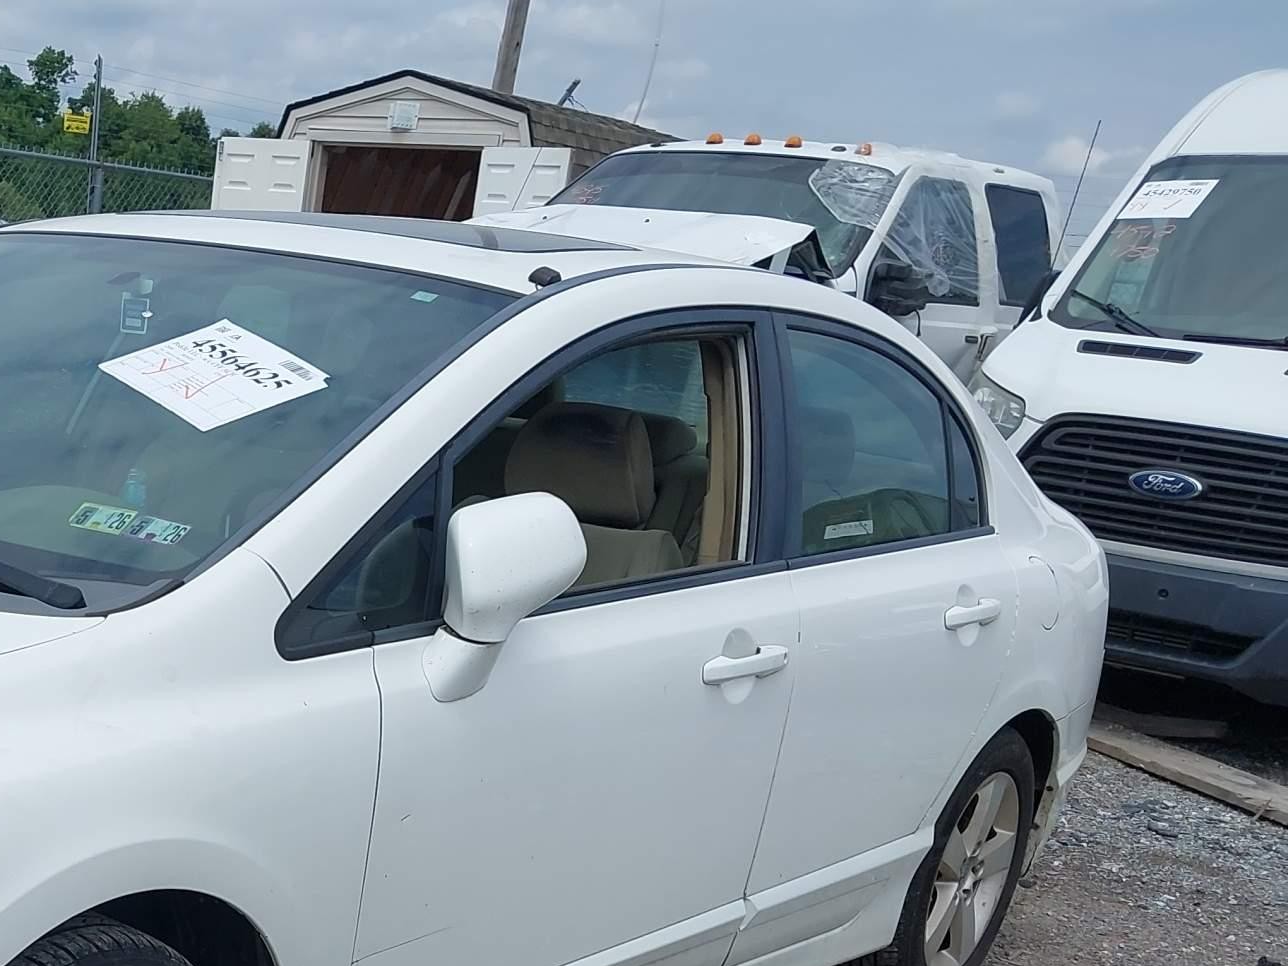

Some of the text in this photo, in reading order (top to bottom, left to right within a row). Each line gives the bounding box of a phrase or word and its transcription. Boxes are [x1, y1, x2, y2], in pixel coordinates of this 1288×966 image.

[192, 339, 293, 389] 45564625
[1142, 474, 1184, 493] Ford
[75, 509, 132, 531] 5 26
[128, 520, 187, 543] 5 26
